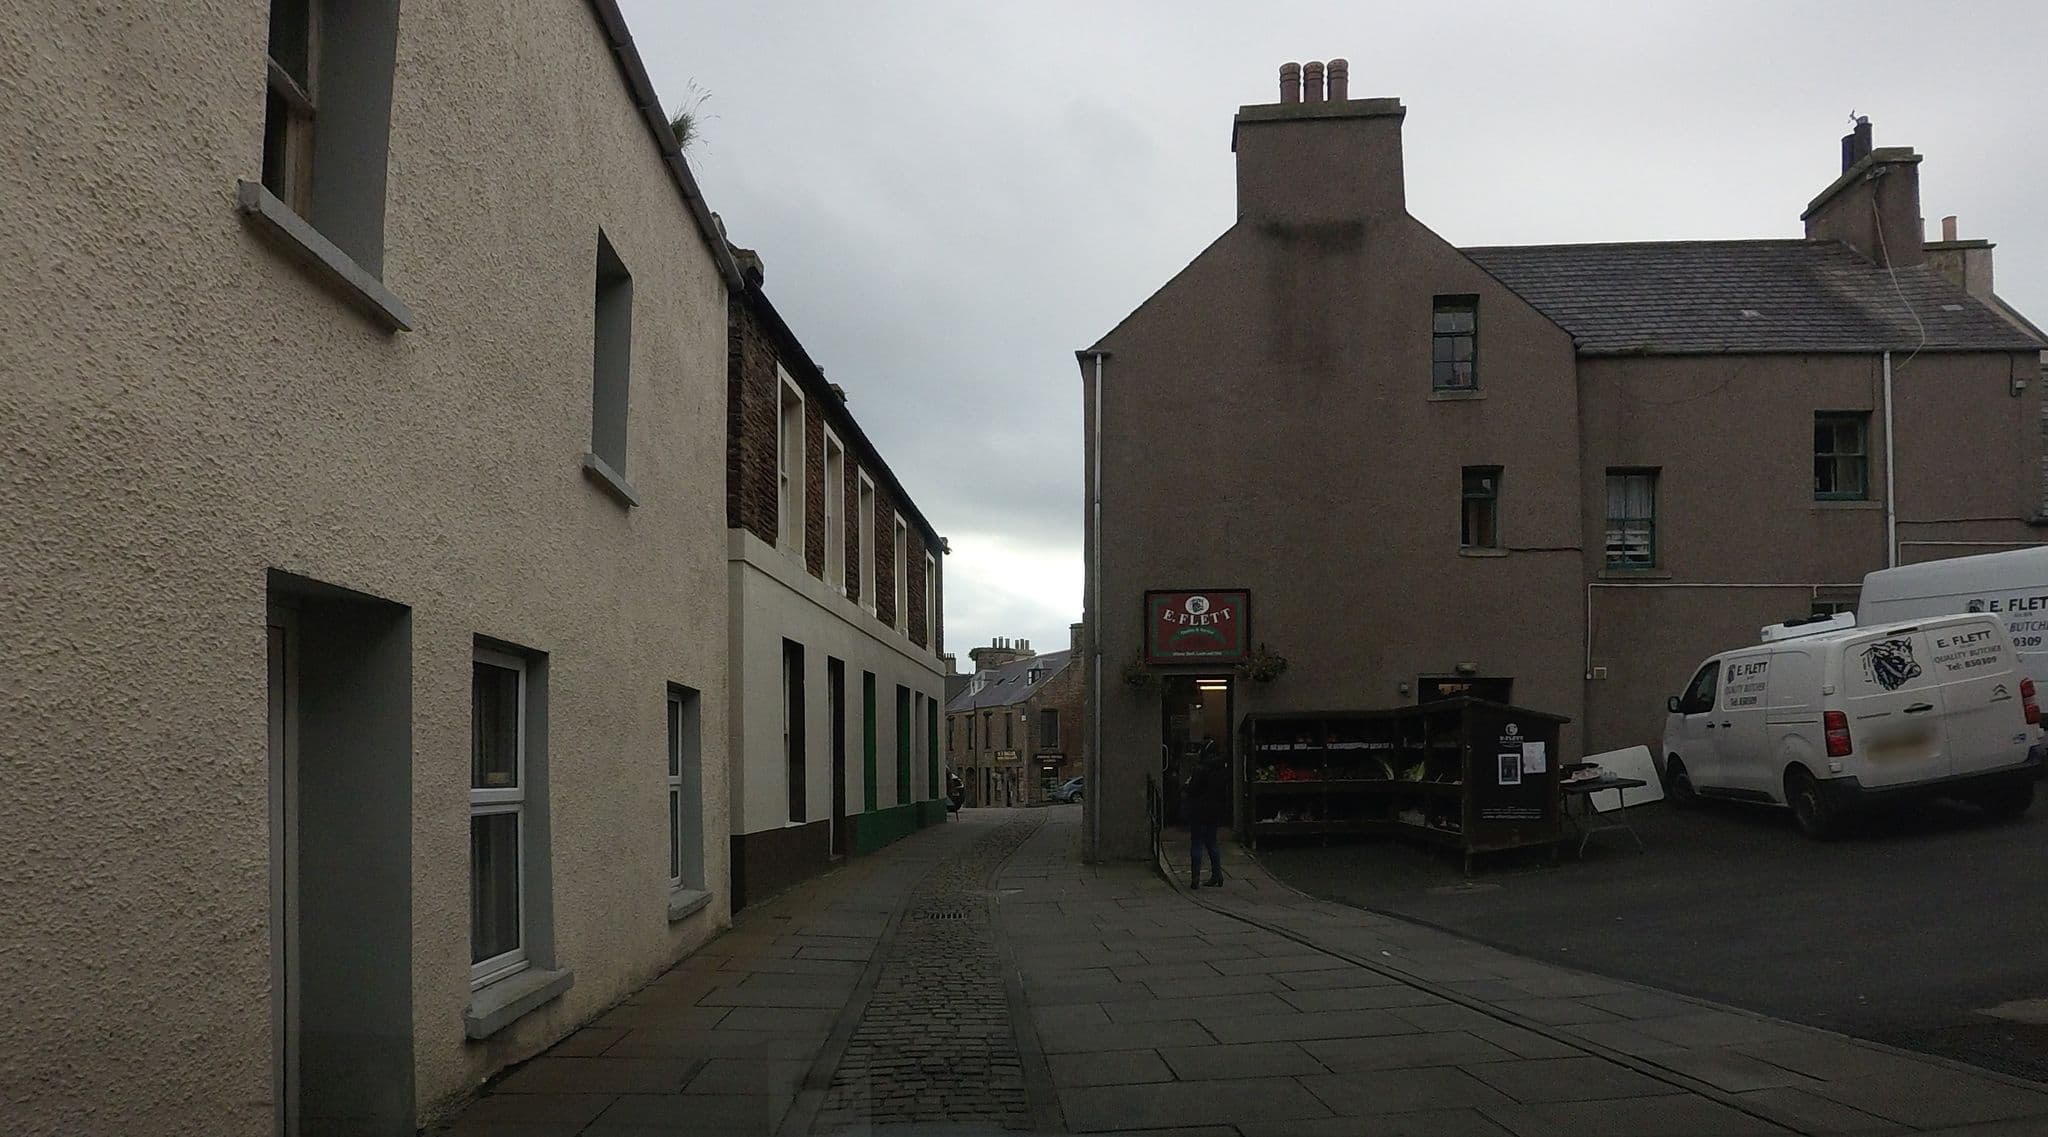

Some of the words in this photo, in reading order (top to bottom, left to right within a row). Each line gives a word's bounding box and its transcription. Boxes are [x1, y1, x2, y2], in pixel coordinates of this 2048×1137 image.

[1990, 600, 2003, 612] E.
[1163, 609, 1175, 623] E.
[1179, 608, 1232, 626] FLETT
[2010, 621, 2048, 632] BUTCH
[1937, 639, 1949, 648] E.
[1952, 630, 1991, 645] FLETT
[1745, 662, 1768, 675] FLETT
